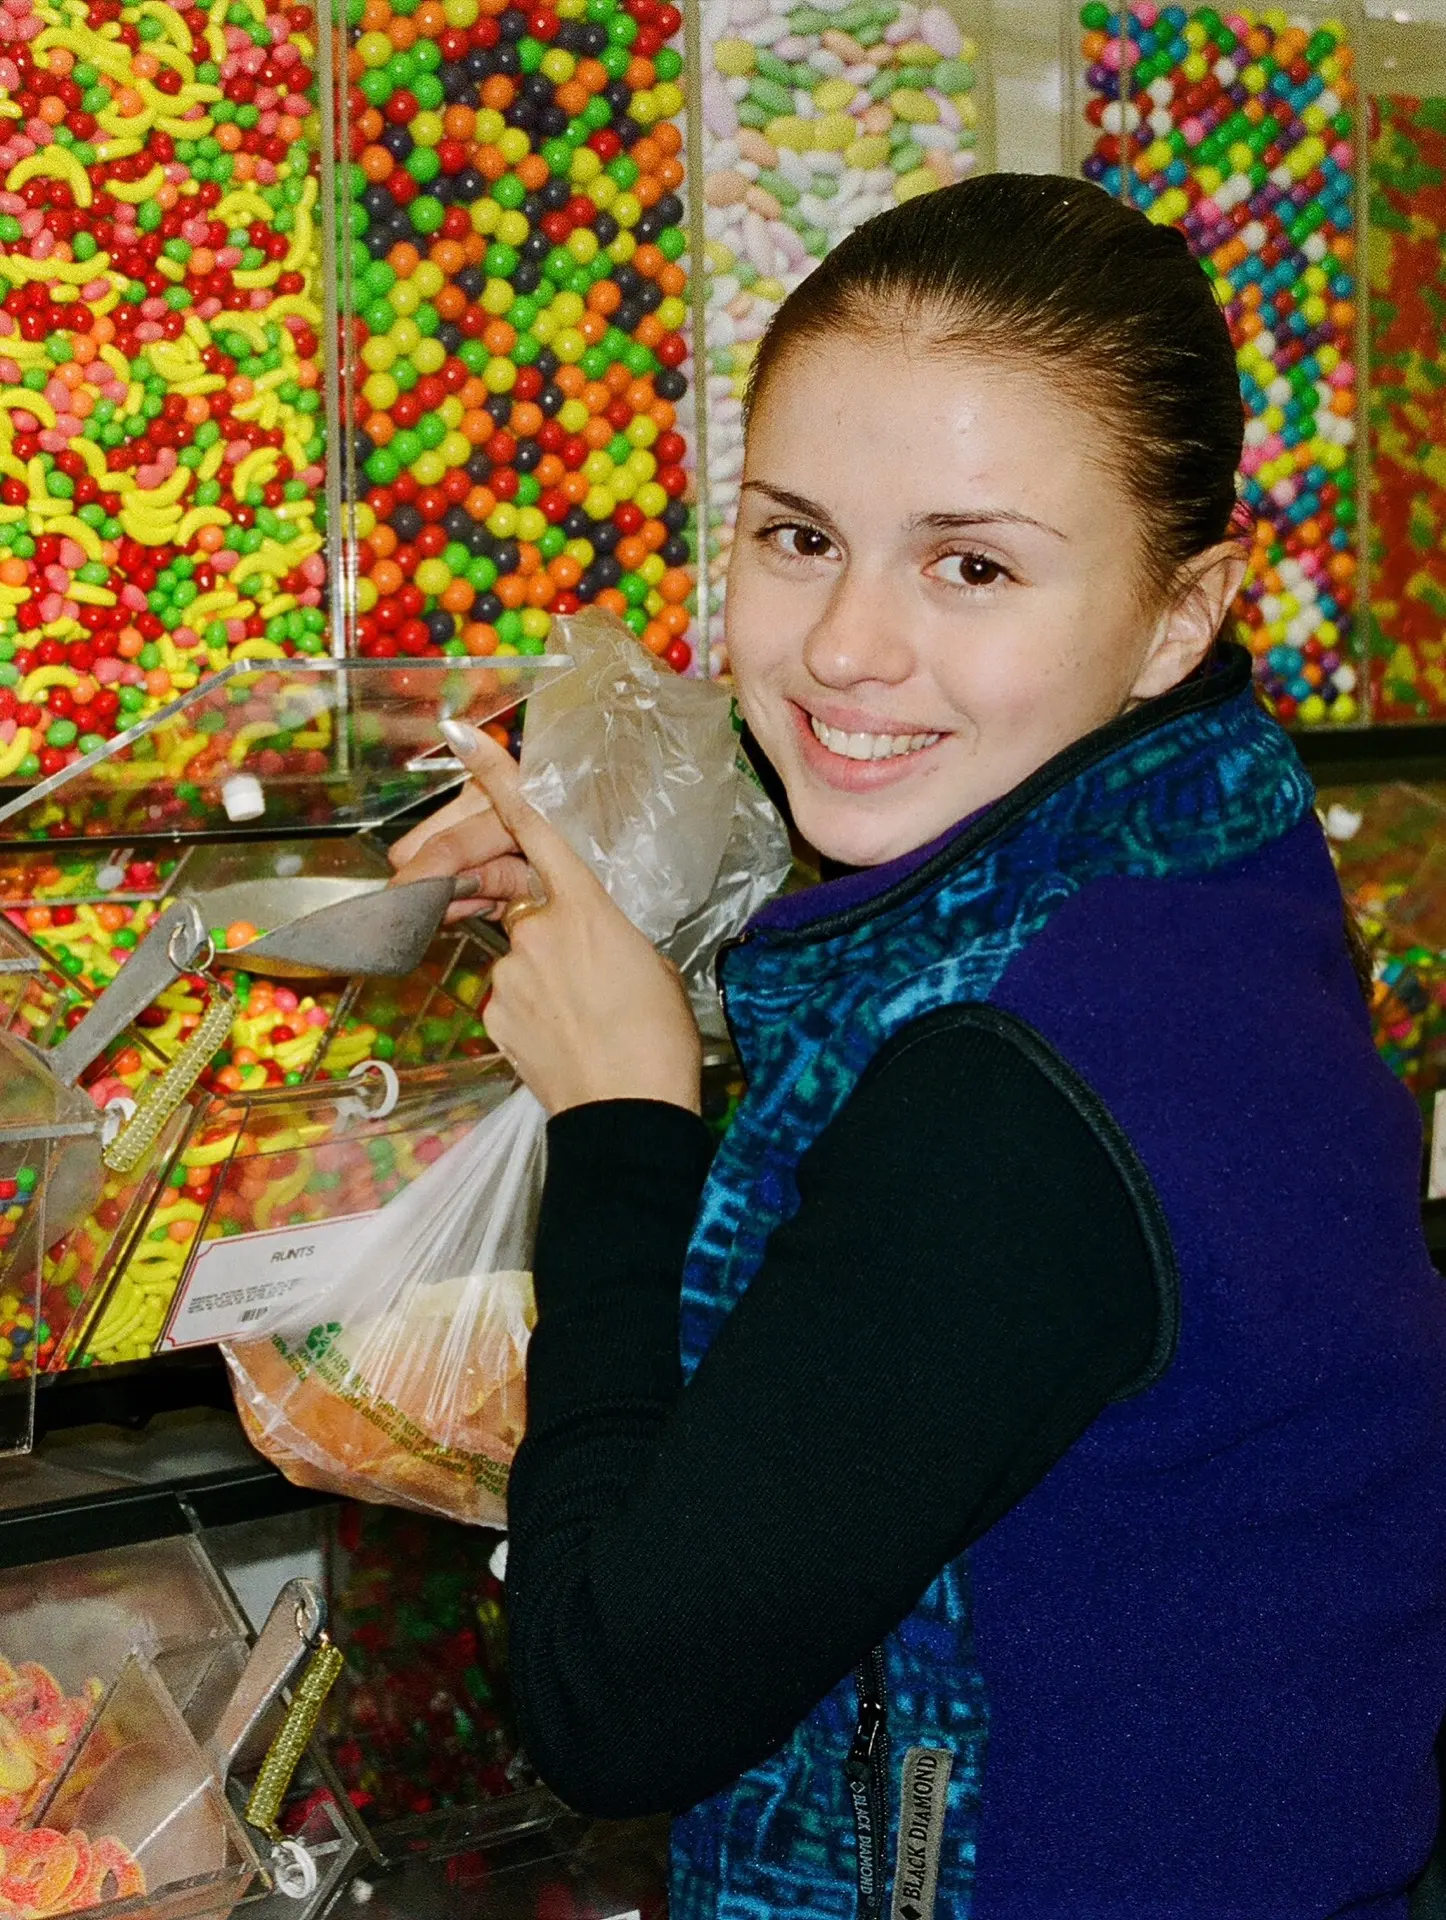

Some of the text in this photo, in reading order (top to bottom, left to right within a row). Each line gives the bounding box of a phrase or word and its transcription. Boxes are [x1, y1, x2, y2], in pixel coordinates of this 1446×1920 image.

[271, 1245, 316, 1263] RUNTS
[361, 1405, 396, 1436] BABIES
[402, 1419, 424, 1441] NOT
[903, 1755, 938, 1900] BLACK DIAMOND
[853, 1794, 873, 1895] BLACK DIAMOND
